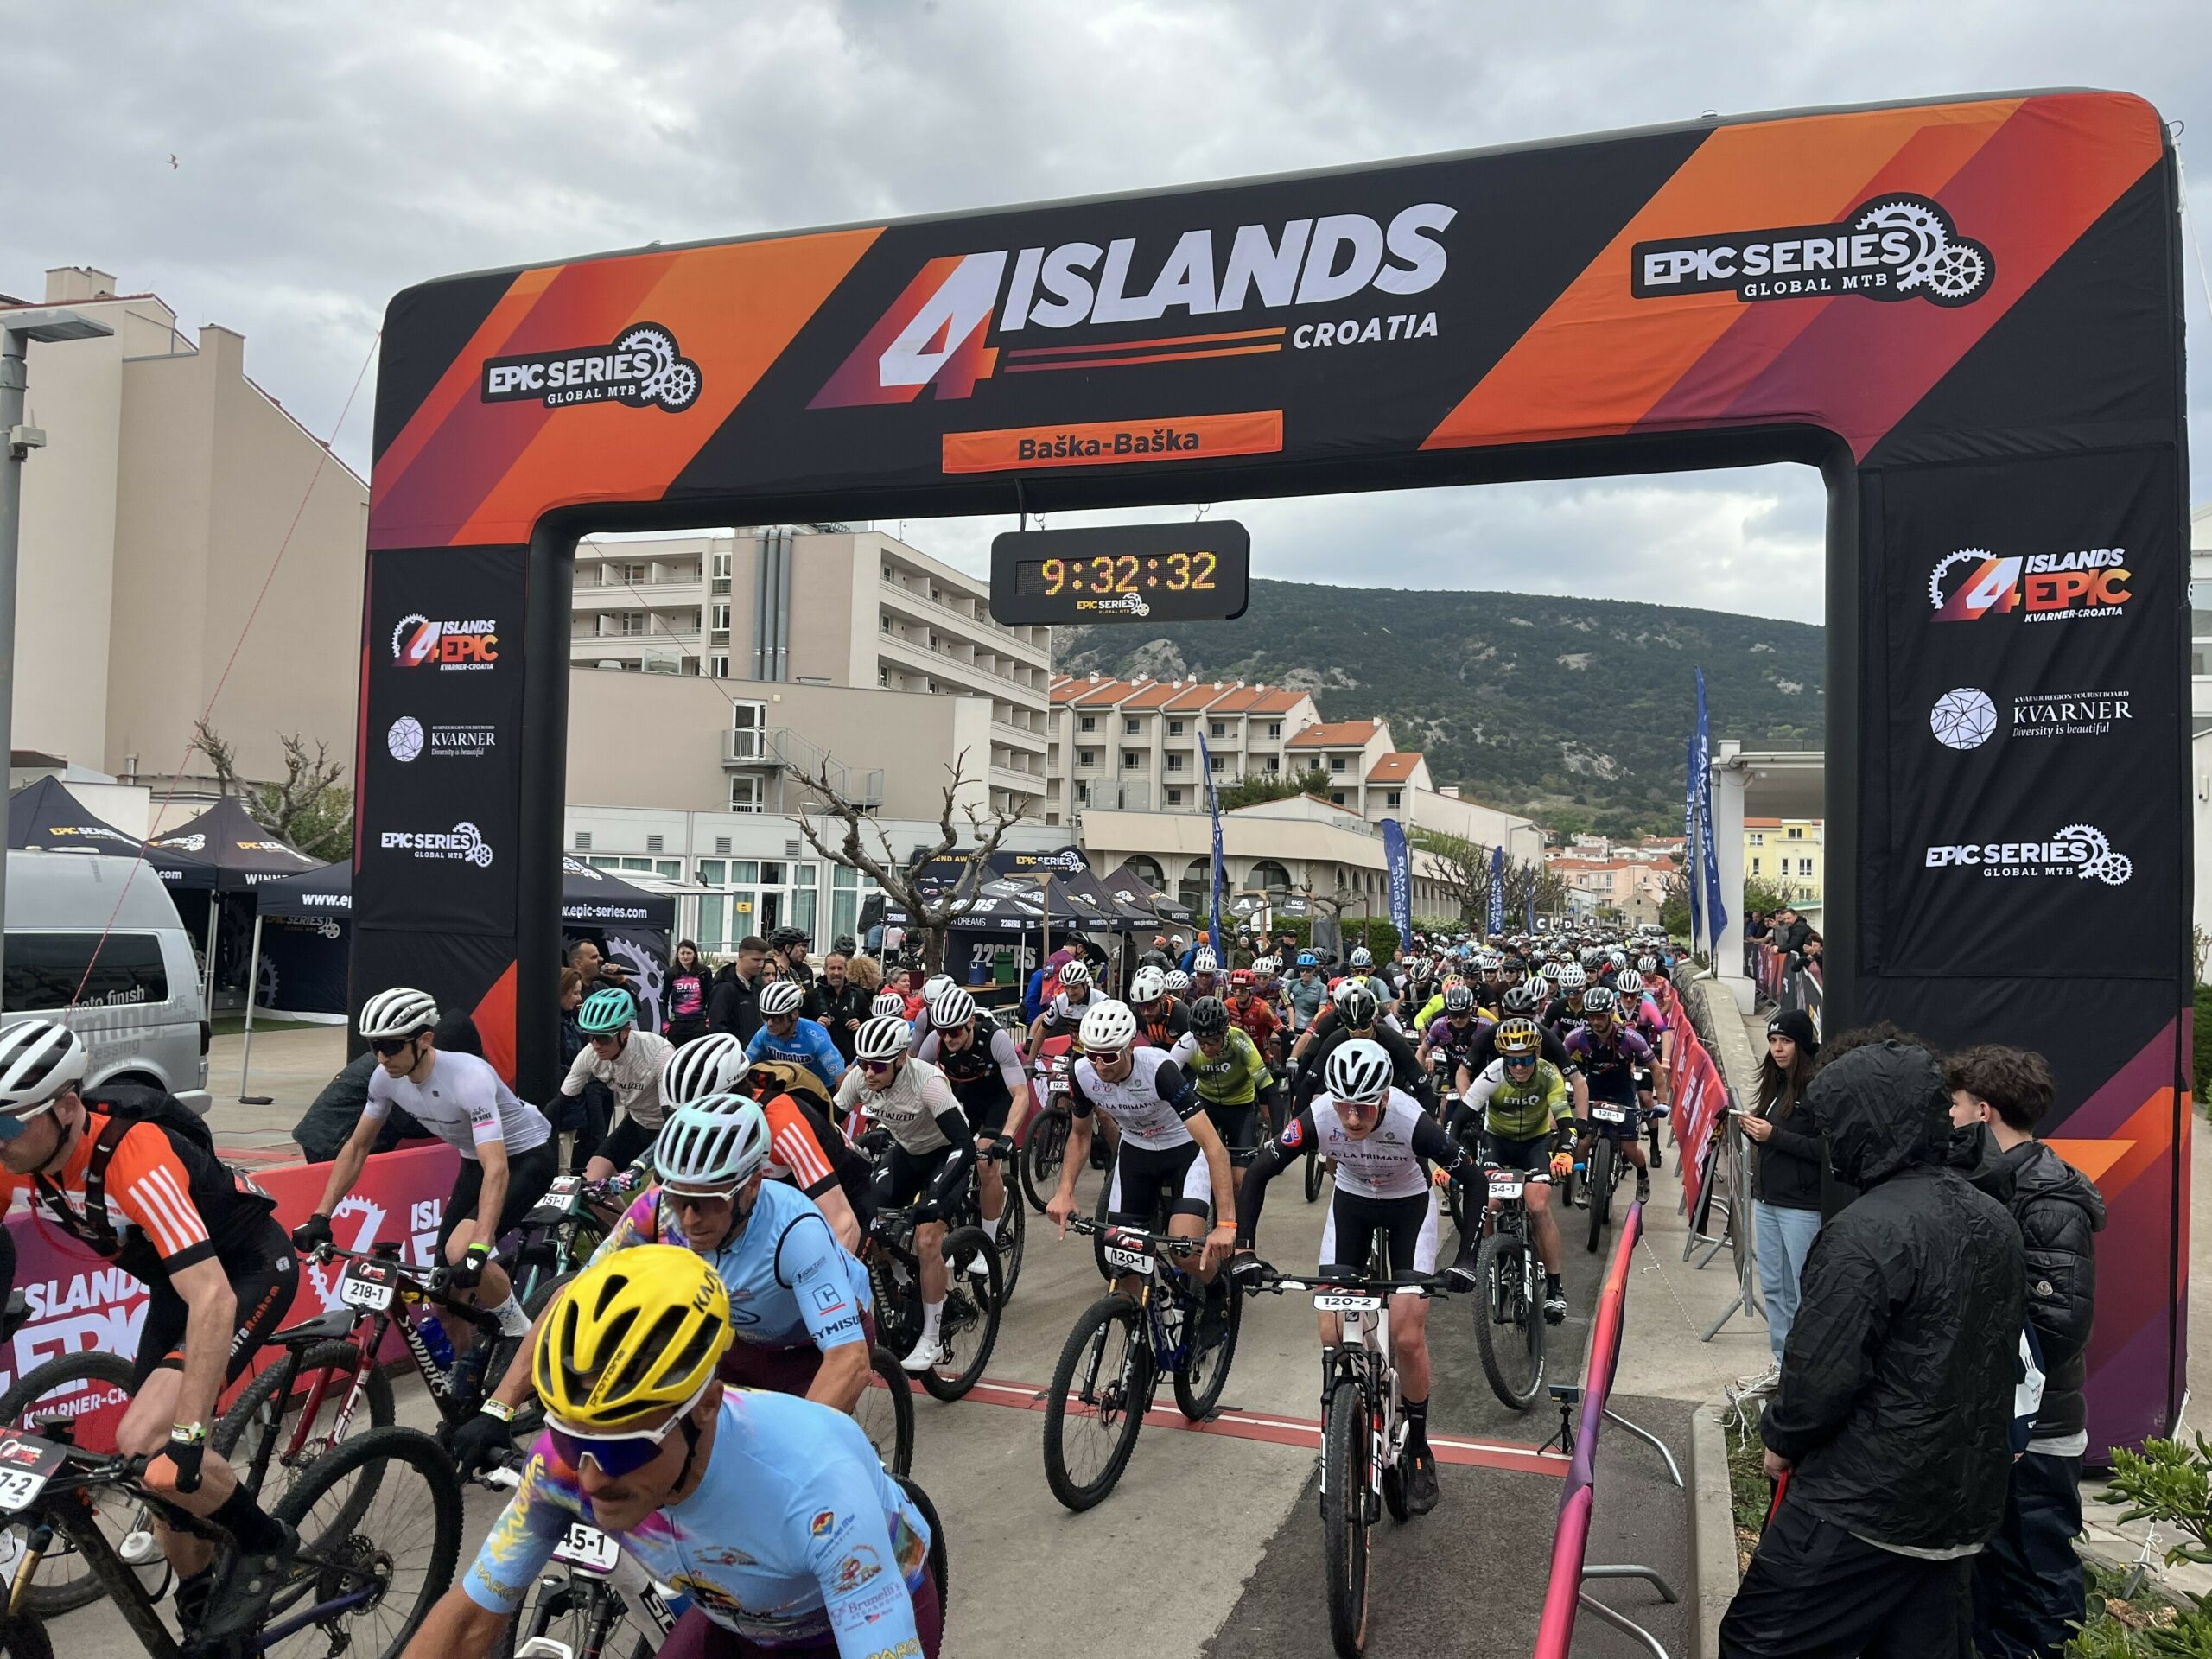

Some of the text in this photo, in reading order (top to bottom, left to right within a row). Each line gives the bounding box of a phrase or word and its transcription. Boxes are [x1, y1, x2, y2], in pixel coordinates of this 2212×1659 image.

[1644, 231, 1910, 285] EPIC SERIES
[1745, 274, 1888, 296] GLOBAL MTB
[879, 203, 1458, 400] 4 ISLANDS
[1293, 312, 1439, 349] CROATIA
[489, 352, 652, 393] EPIC SERIES
[547, 385, 636, 404] GLOBAL MTB
[1018, 430, 1200, 461] Baška-Baška
[2025, 548, 2125, 574] ISLANDS
[1042, 551, 1217, 595] 9:32:32
[1966, 556, 2132, 613] 4 EPIC
[1077, 599, 1135, 610] EPIC SERIES
[2024, 607, 2122, 622] KVARNER-CROATIA
[442, 620, 496, 634] ISLANDS
[442, 635, 499, 663] EPIC
[2013, 701, 2133, 724] KVARNER
[431, 732, 495, 746] KVARNER
[2012, 722, 2110, 737] Diversity is beautiful
[381, 832, 471, 849] EPIC SERIES
[1016, 855, 1037, 865] EPIC
[1925, 842, 2088, 867] EPIC SERIES
[1984, 867, 2073, 877] GLOBAL MTB
[957, 917, 986, 926] DREAMS
[1001, 919, 1021, 928] 226ERS
[1536, 918, 1546, 929] C
[1564, 920, 1572, 929] D
[107, 984, 145, 1005] finish
[1360, 1154, 1408, 1162] PRIMAFIT
[1113, 1250, 1146, 1268] 120-1
[350, 1282, 384, 1301] 218-1
[397, 1314, 452, 1398] S-WORKS
